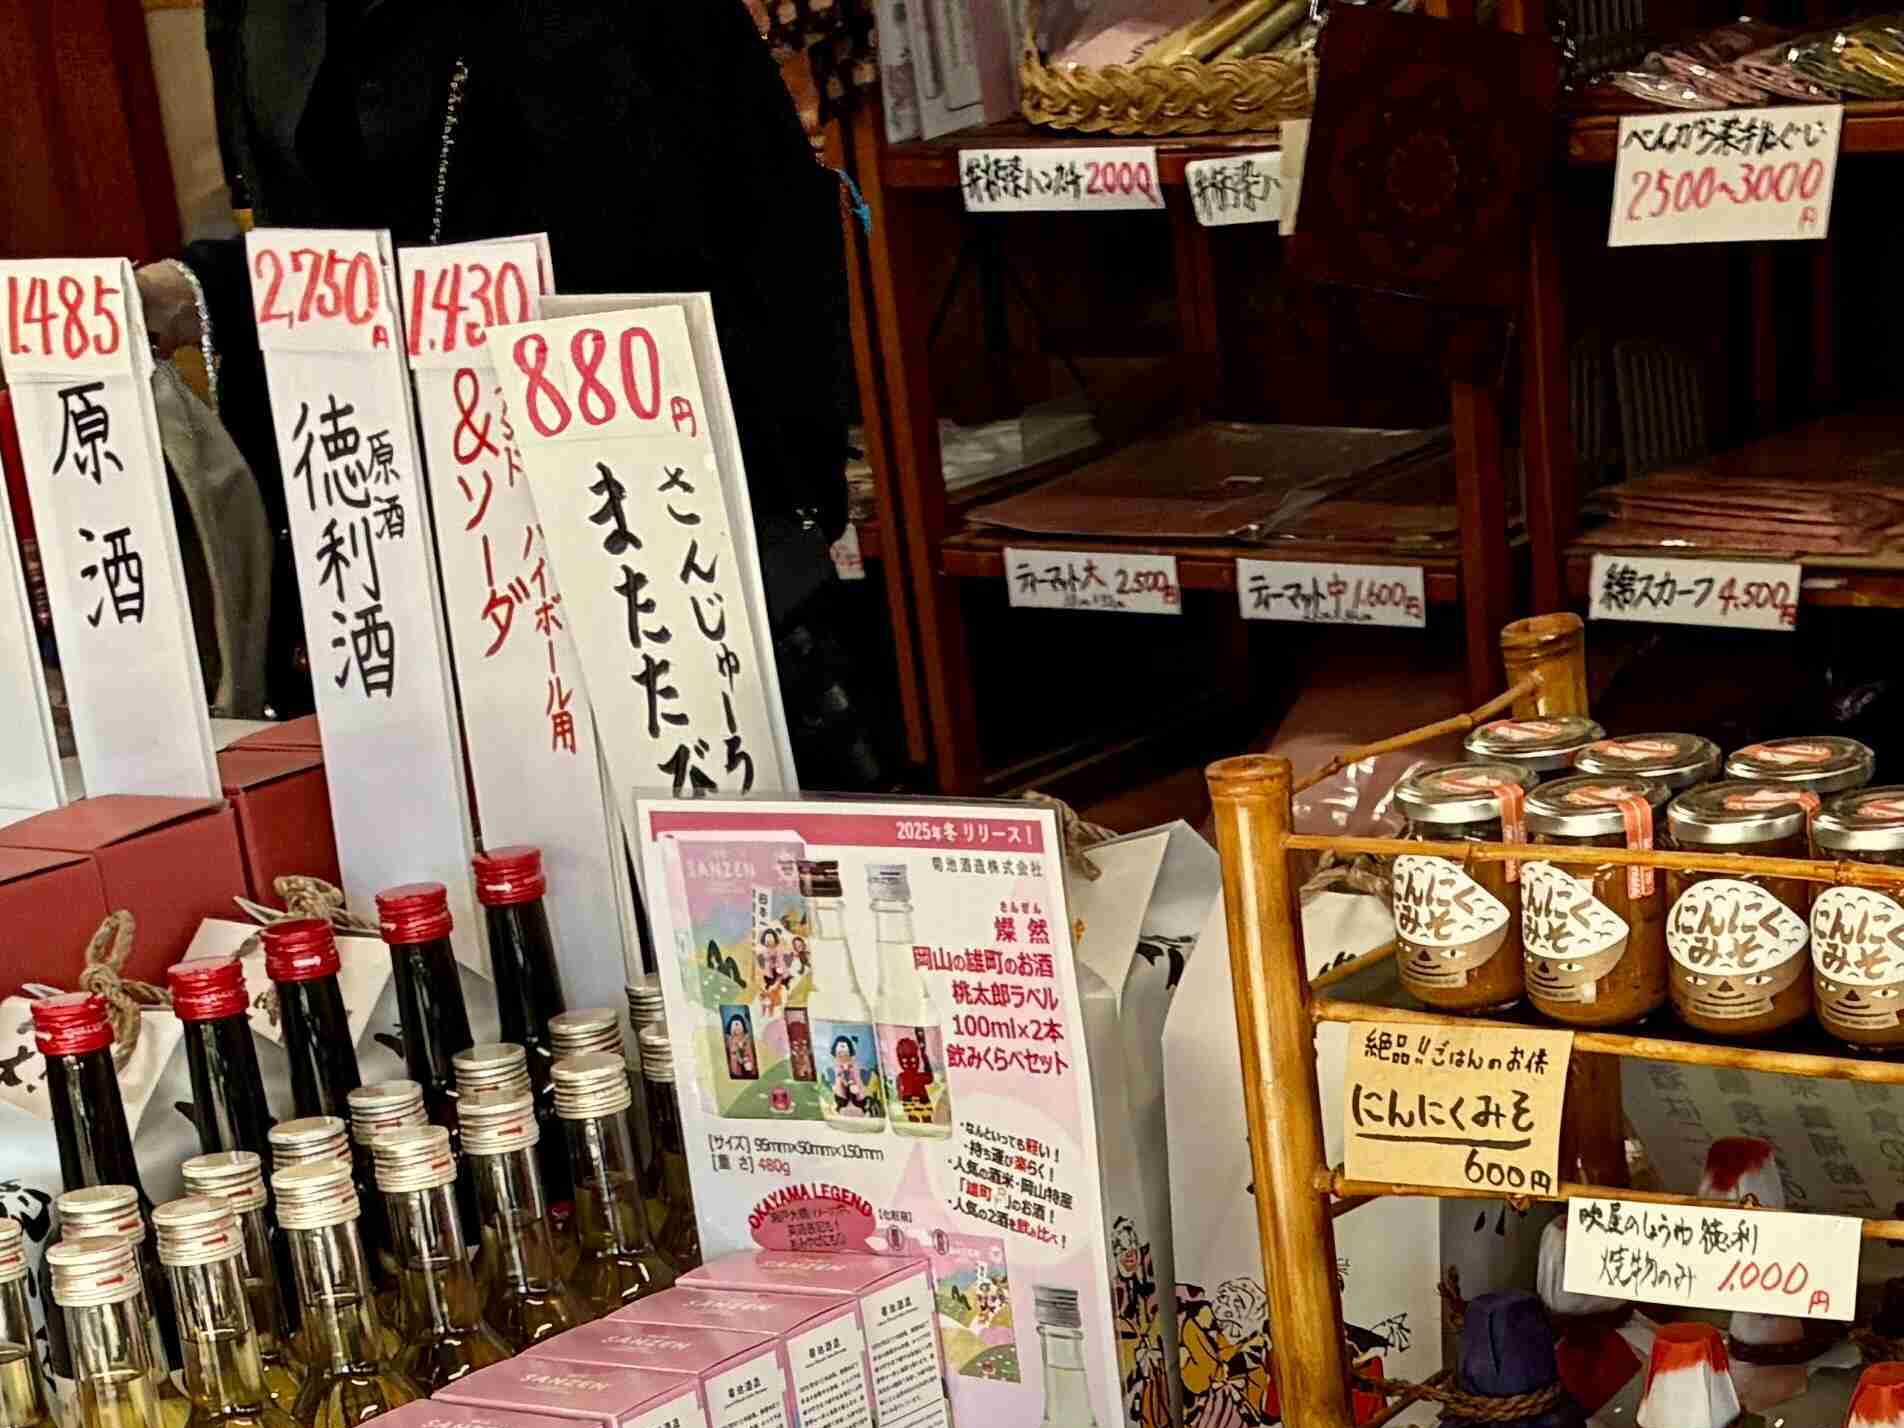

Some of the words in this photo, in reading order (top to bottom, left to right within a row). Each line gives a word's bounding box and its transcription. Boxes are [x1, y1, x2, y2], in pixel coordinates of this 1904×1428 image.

[365, 429, 407, 540] 原酒
[52, 380, 146, 628] 原酒
[292, 393, 398, 700] 徳利酒
[1674, 904, 1783, 941] にんにく
[912, 945, 1054, 979] 岡山の雄町のお酒
[1687, 932, 1763, 966] みそ
[1821, 944, 1890, 979] みそ
[951, 980, 1059, 1011] 桃太郎ラベル
[947, 1044, 1069, 1076] 飲みくらべセット
[1352, 1083, 1535, 1135] にんにくみそ
[1463, 1149, 1552, 1192] 600円
